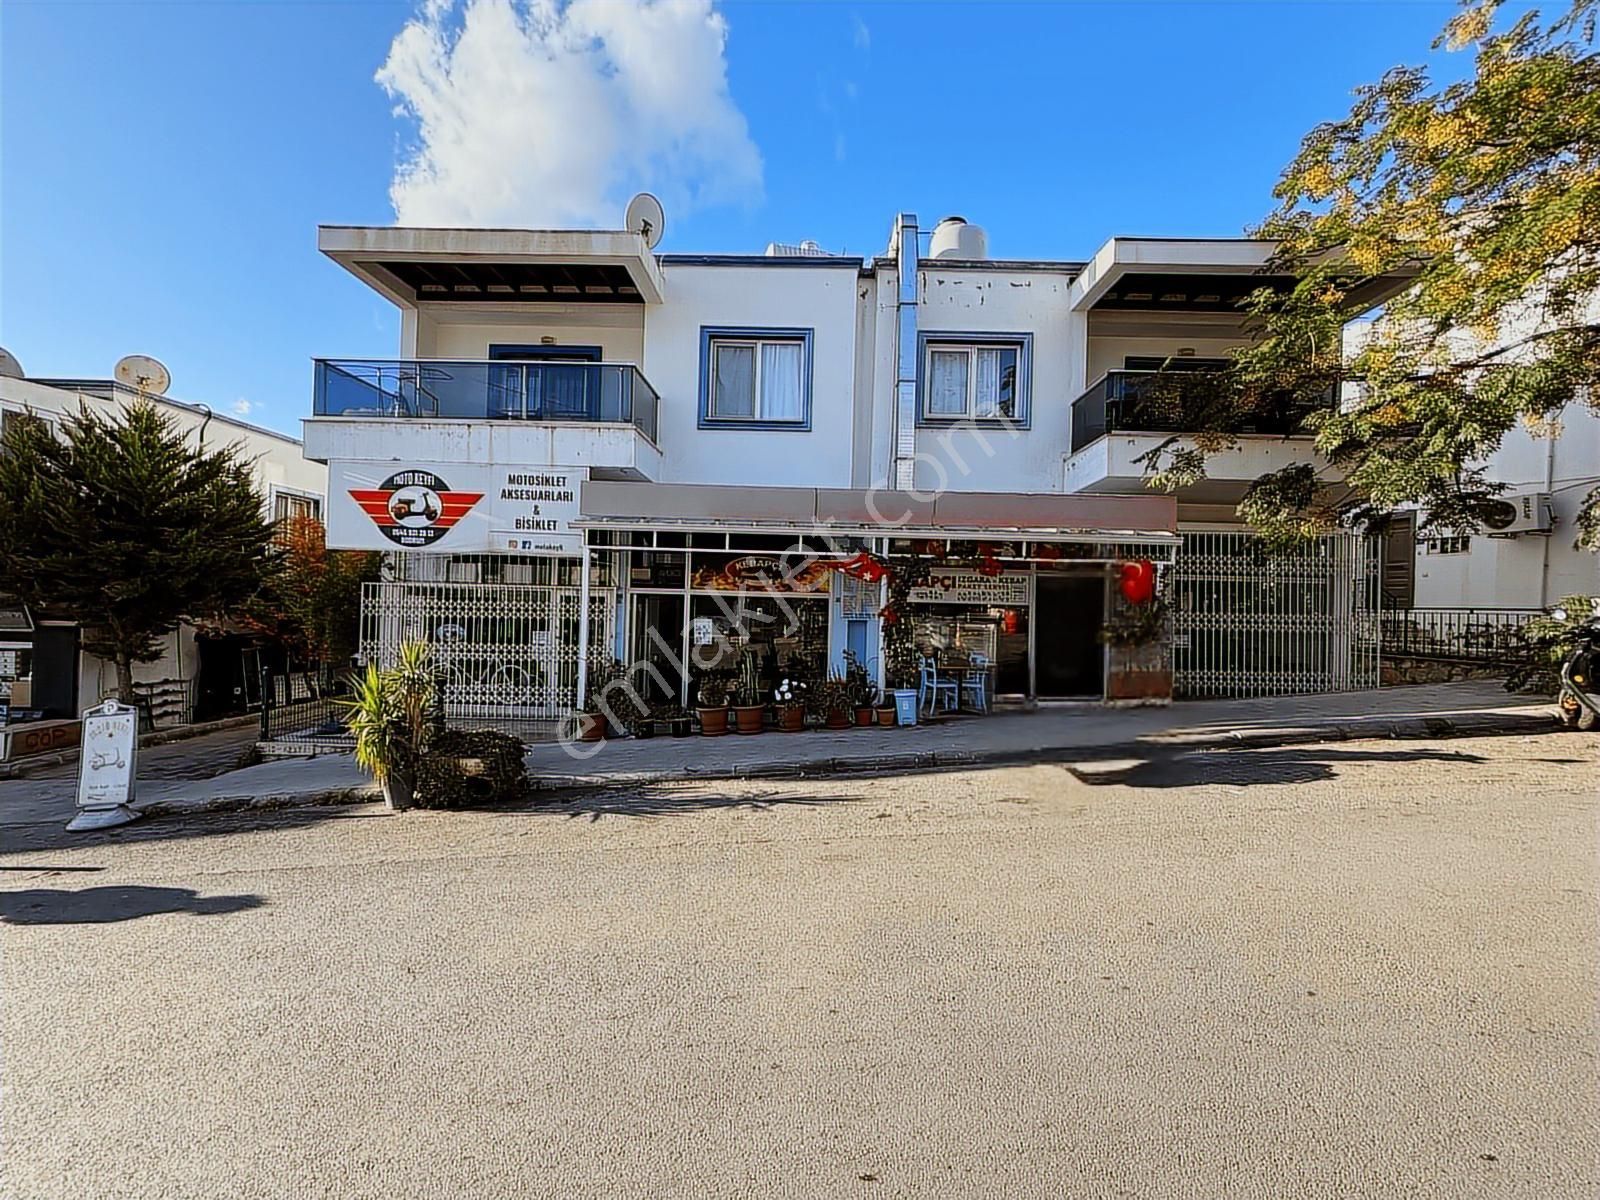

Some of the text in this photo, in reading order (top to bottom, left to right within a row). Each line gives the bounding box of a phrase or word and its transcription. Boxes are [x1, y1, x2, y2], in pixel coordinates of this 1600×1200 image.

[508, 473, 567, 487] MOTOSİKLET
[500, 488, 573, 502] AKSESUARLARI
[533, 504, 540, 516] &
[515, 516, 557, 531] BİSİKLET
